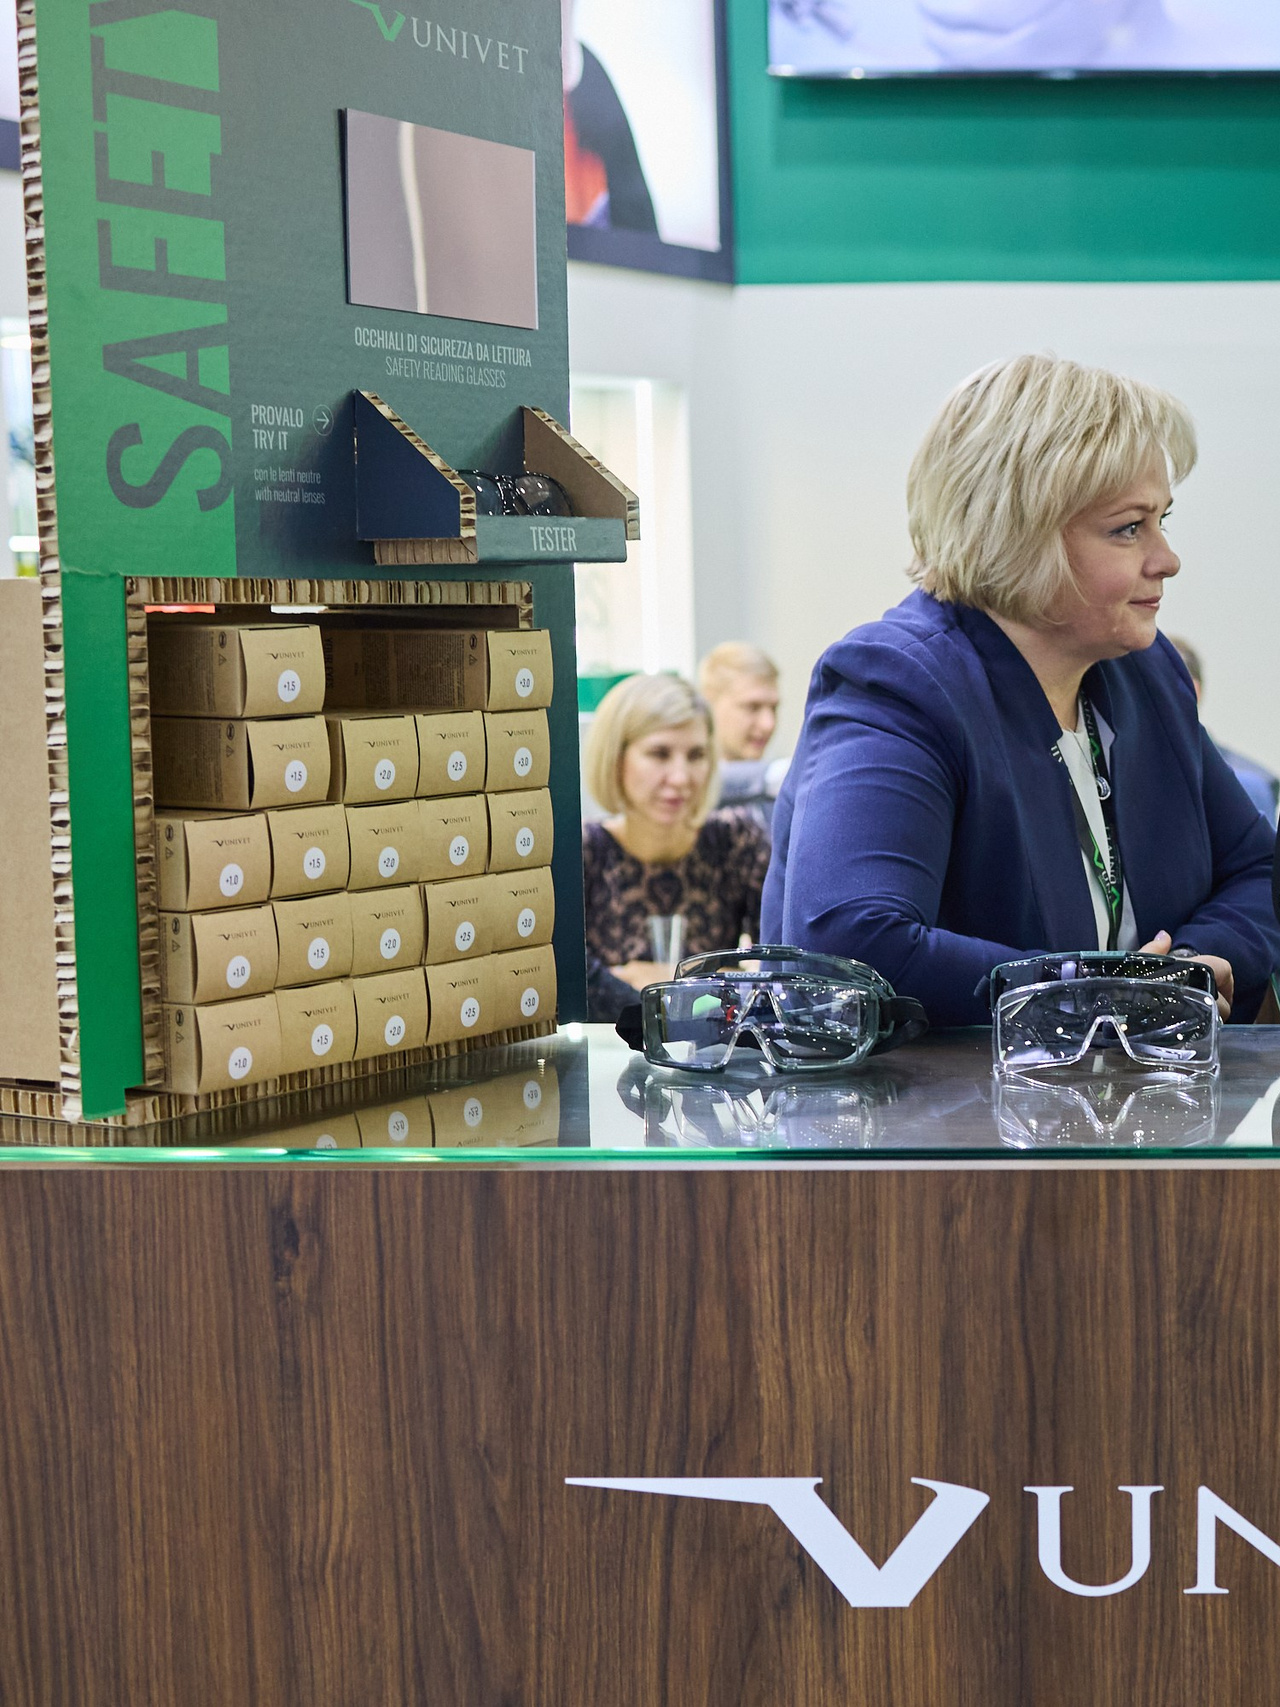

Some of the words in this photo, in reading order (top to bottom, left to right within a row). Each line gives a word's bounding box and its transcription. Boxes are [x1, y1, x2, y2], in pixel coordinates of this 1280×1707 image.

[411, 17, 529, 74] UNIVET
[354, 326, 404, 352] OCCHIALI
[407, 333, 418, 353] DI
[420, 335, 474, 360] SICUREZZA
[476, 342, 489, 362] DA
[492, 344, 532, 367] LETTURA
[386, 356, 421, 379] SAFETY
[423, 361, 465, 384] READING
[466, 366, 506, 388] GLASSES
[251, 403, 304, 428] PROVALO
[252, 428, 275, 450] TRY
[278, 431, 288, 451] IT
[254, 468, 269, 481] con
[270, 466, 277, 482] le
[278, 467, 295, 483] lenti
[297, 469, 321, 484] neutre
[255, 486, 272, 501] with
[273, 487, 300, 503] neutral
[301, 488, 326, 504] lenses
[530, 525, 577, 552] TESTER
